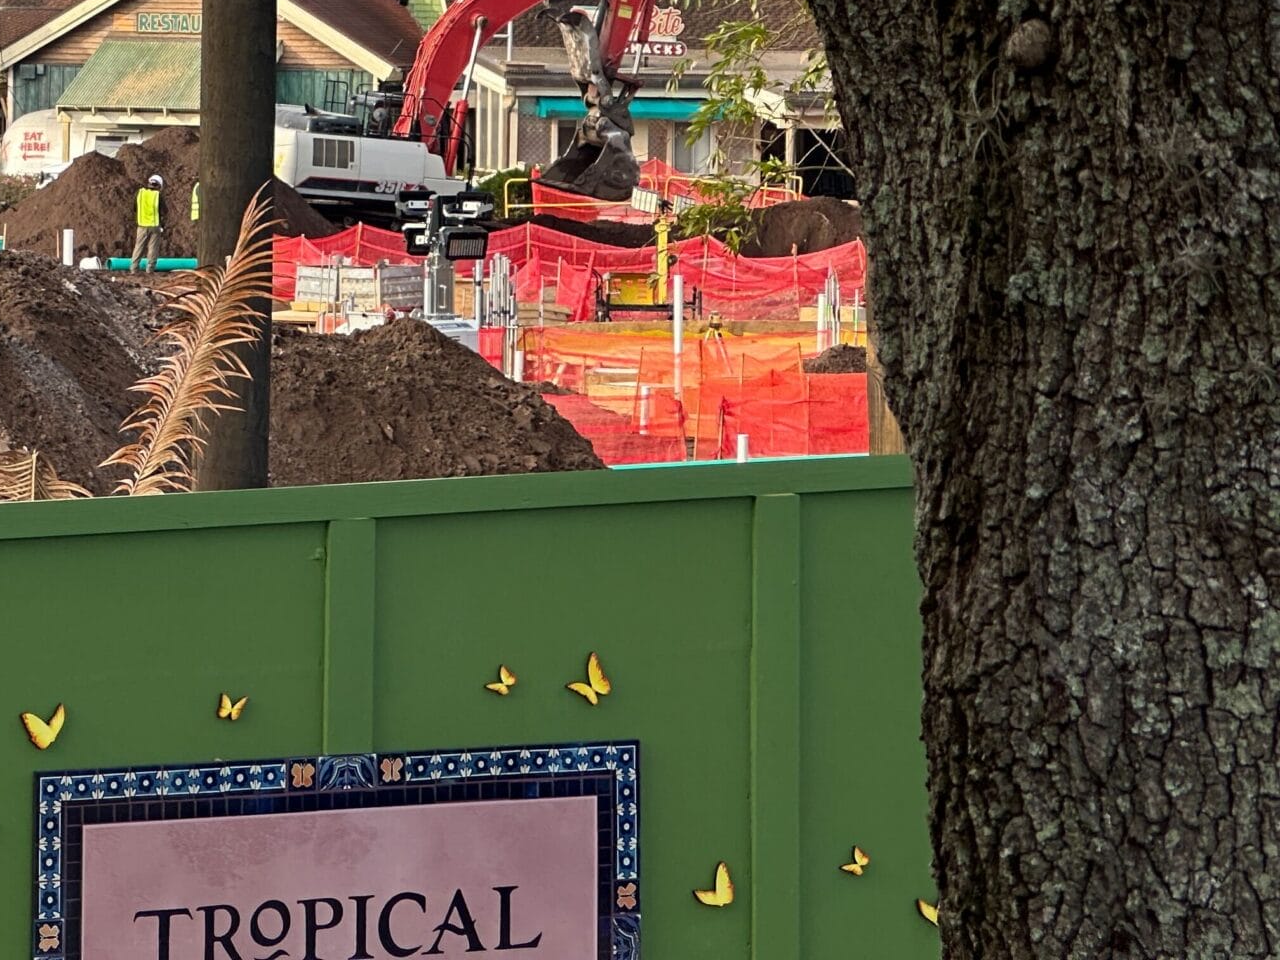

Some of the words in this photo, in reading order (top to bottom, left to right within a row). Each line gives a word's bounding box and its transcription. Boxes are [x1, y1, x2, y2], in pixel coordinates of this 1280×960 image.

[138, 13, 202, 33] RESTAU
[23, 132, 43, 141] EAT
[20, 142, 50, 152] HERE!
[133, 885, 543, 960] TROPICAL
